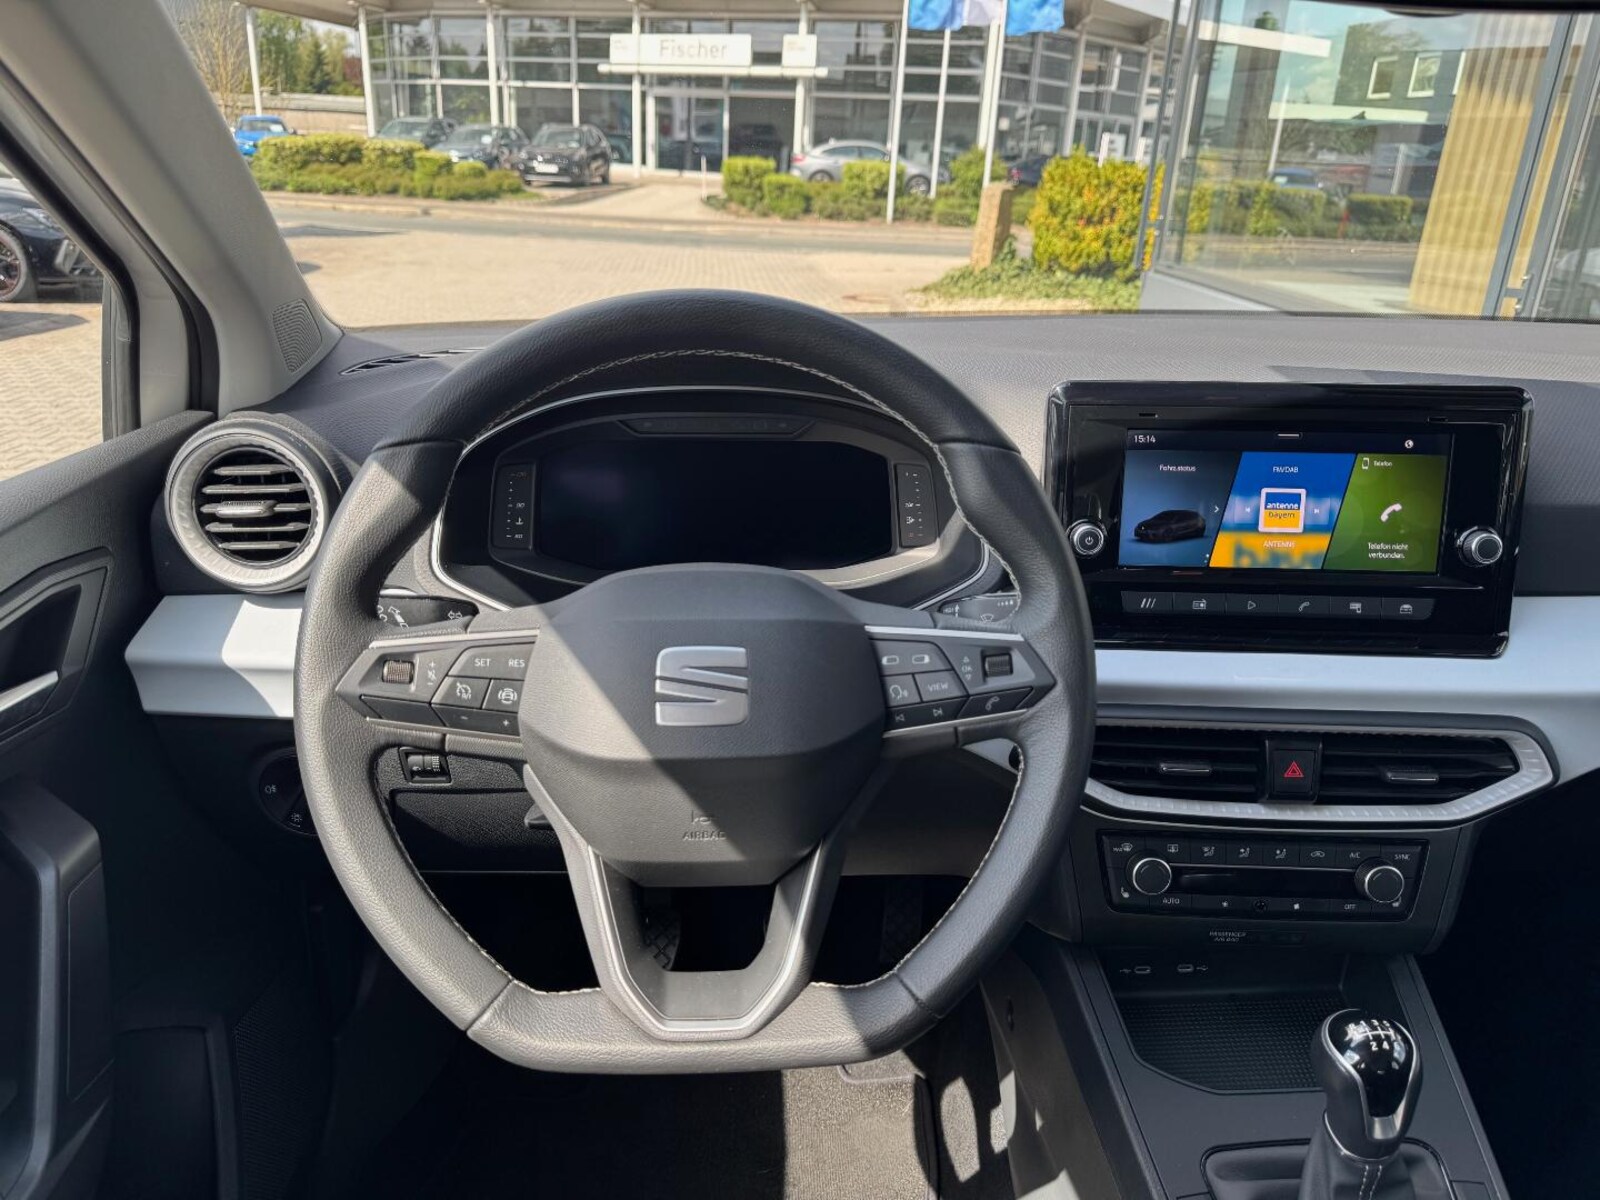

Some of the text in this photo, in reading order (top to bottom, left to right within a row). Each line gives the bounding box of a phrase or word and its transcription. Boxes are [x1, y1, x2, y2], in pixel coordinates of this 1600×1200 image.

[659, 39, 727, 58] Fischer
[1134, 434, 1157, 443] 15:14
[1266, 502, 1299, 510] antenne
[1268, 511, 1296, 519] bayern
[1368, 542, 1391, 550] Telefon
[474, 658, 491, 667] SET
[508, 659, 526, 668] RES
[927, 682, 949, 692] VIEW
[1162, 897, 1180, 905] AUTO
[1370, 1041, 1378, 1051] 2
